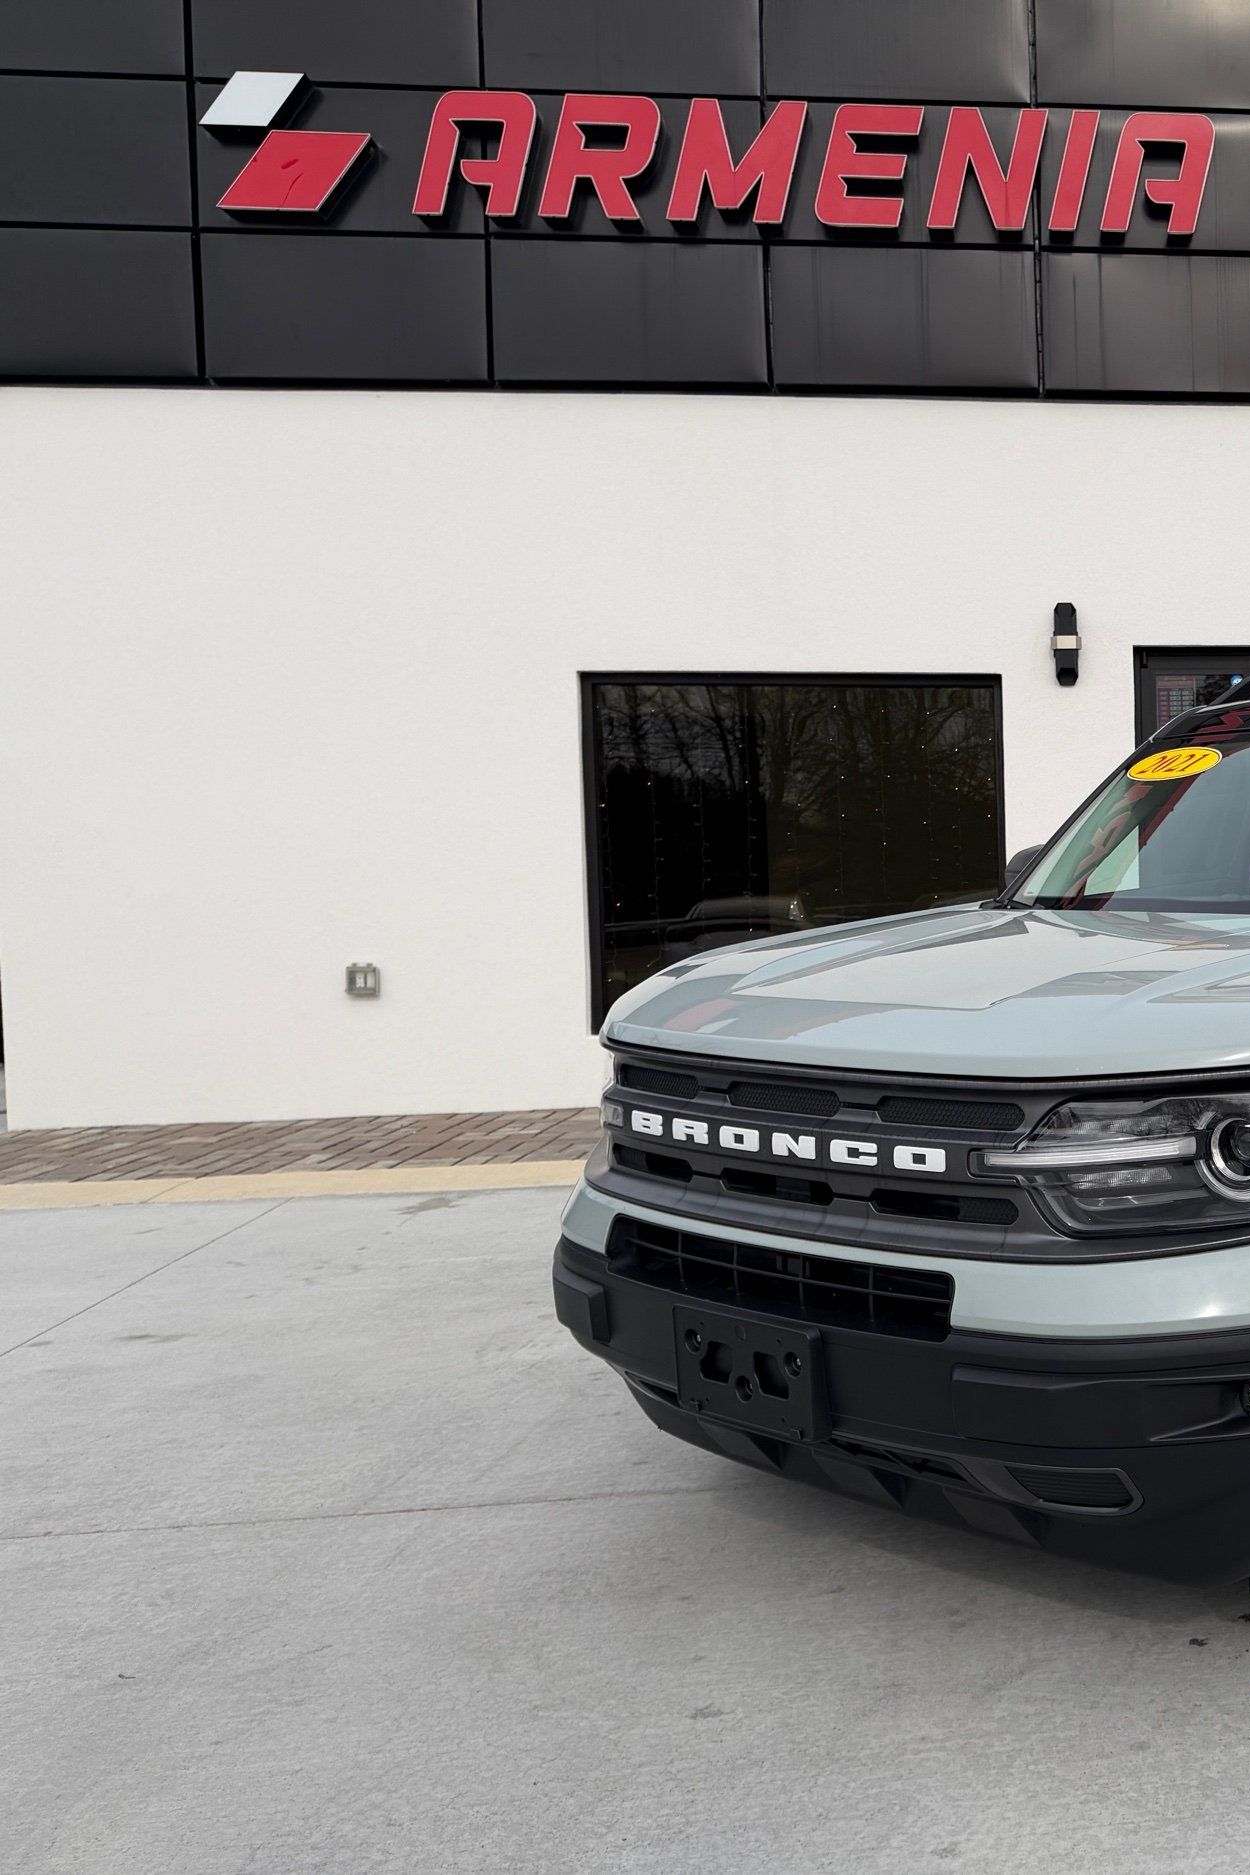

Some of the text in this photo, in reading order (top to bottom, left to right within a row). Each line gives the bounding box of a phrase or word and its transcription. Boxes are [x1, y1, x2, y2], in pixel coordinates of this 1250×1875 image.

[412, 90, 1215, 235] ARMENIA
[1136, 753, 1210, 775] 2021
[631, 1109, 946, 1173] BRONCO
